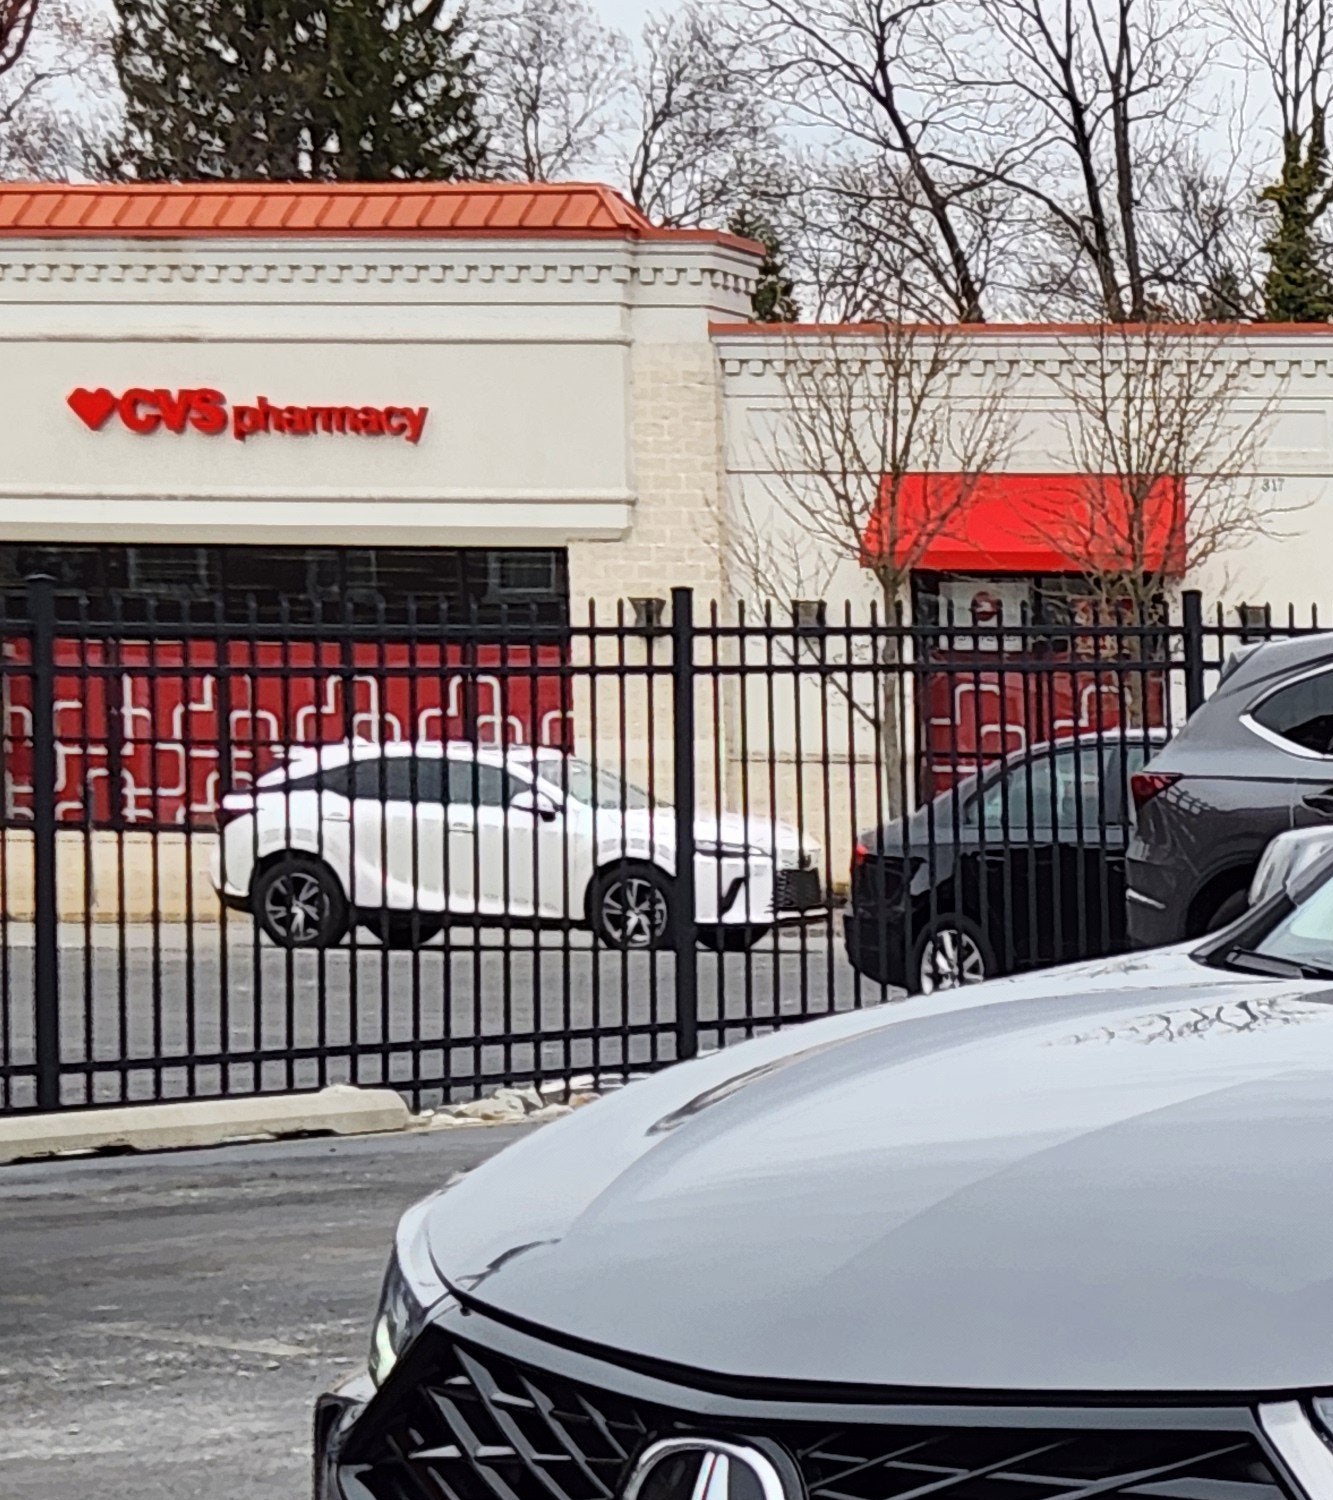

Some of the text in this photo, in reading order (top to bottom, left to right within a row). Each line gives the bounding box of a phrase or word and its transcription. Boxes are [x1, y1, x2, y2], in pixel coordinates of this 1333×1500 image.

[116, 387, 429, 445] CVS pharmacy
[1262, 477, 1285, 492] 317
